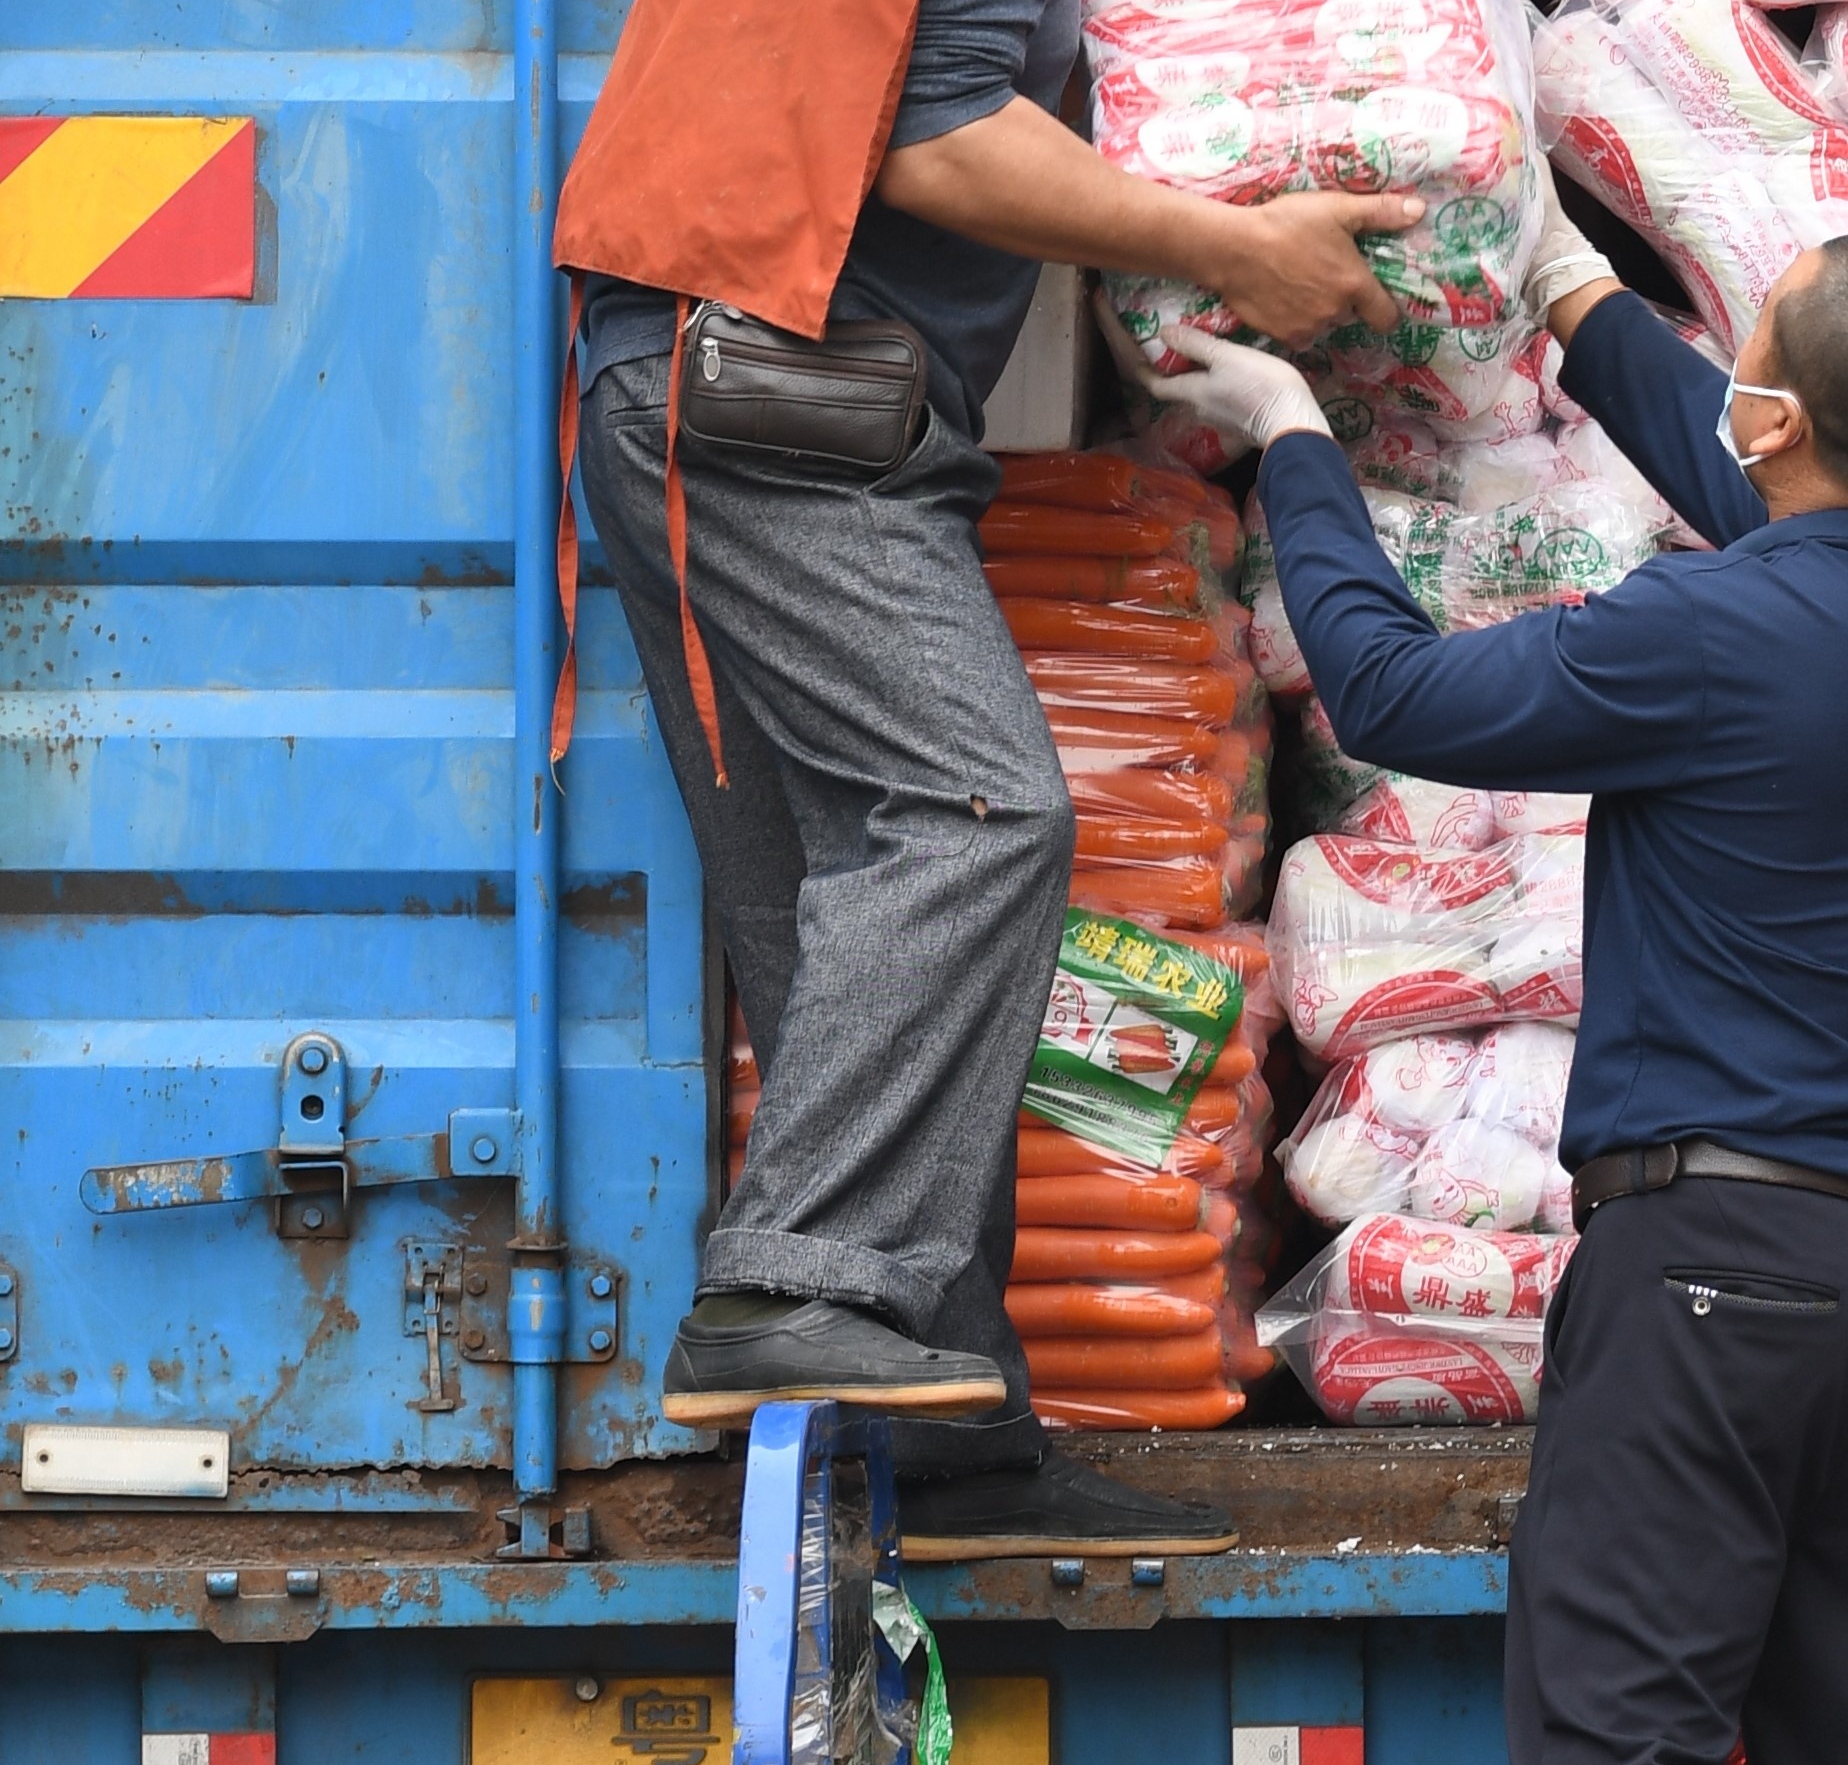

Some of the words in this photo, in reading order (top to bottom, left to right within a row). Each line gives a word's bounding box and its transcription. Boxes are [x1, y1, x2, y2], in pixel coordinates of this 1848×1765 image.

[1075, 920, 1229, 1021] 靖瑞农业
[1412, 1276, 1496, 1318] 鼎盛
